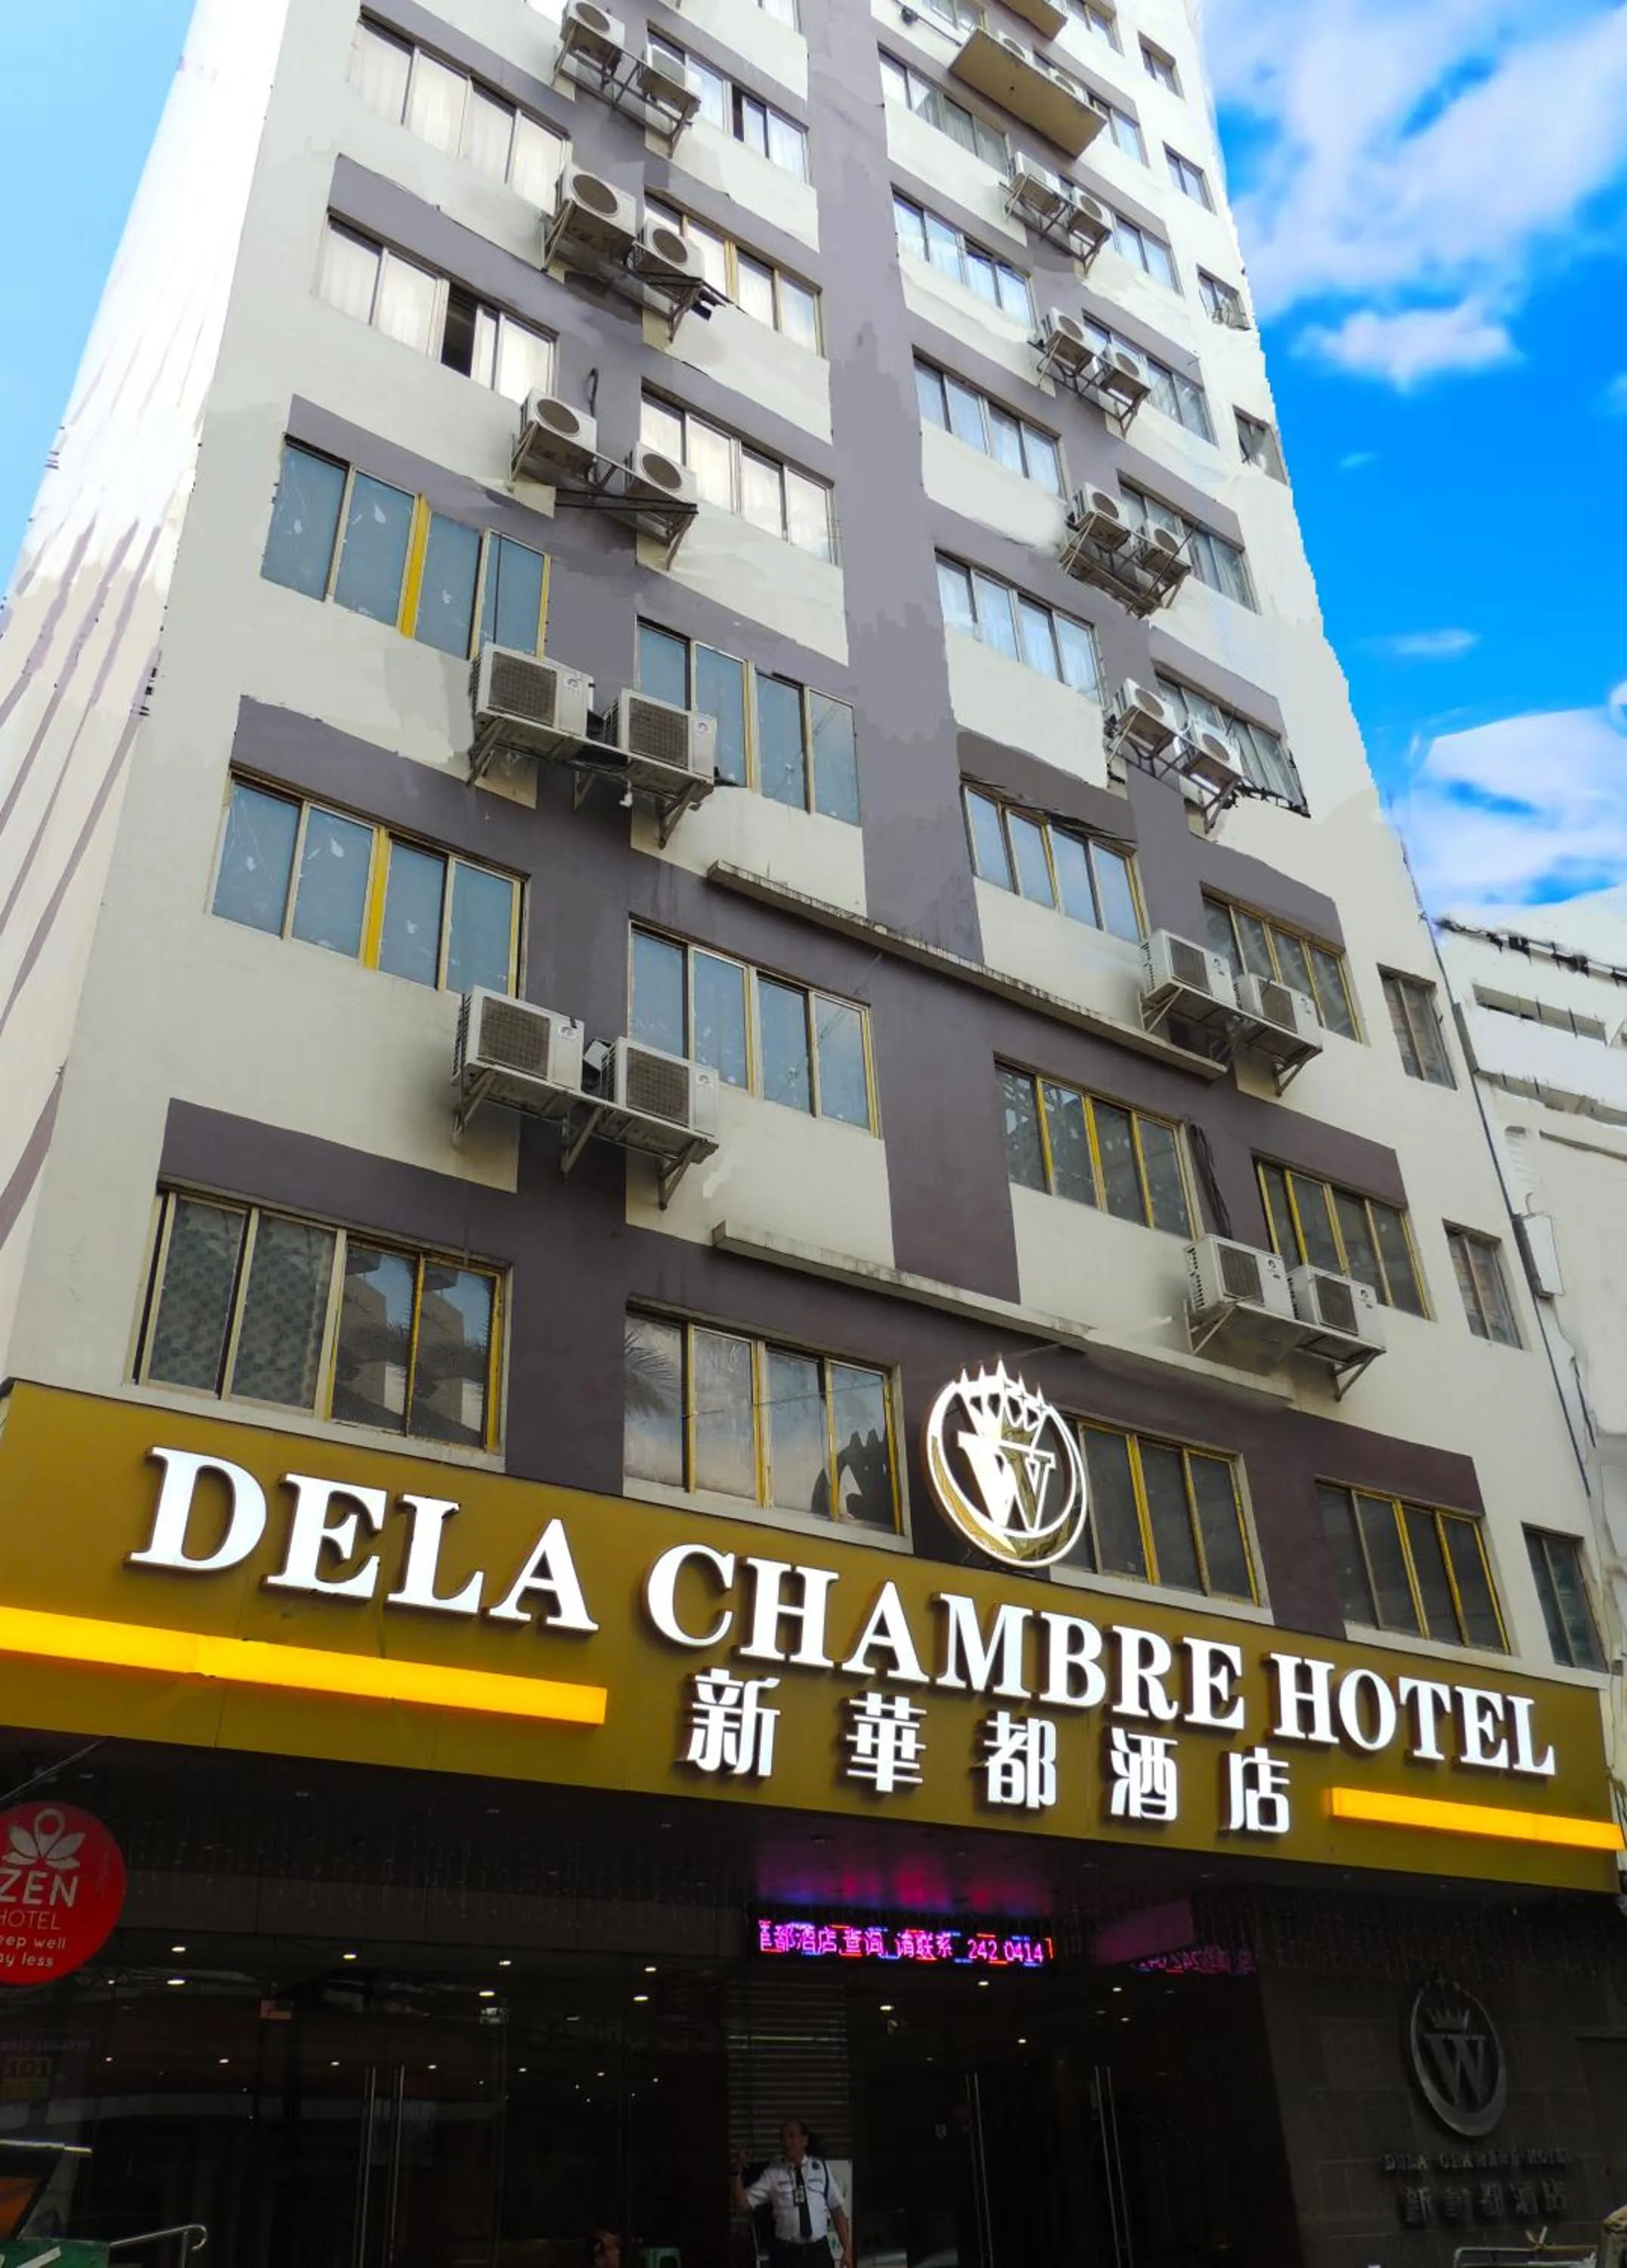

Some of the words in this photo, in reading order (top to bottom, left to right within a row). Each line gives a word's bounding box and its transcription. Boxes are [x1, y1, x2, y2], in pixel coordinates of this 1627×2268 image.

[130, 1446, 600, 1631] DELA
[647, 1544, 1244, 1730] CHAMBRE
[1270, 1653, 1555, 1775] HOTEL
[686, 1668, 1290, 1833] 新華都酒店
[0, 1868, 79, 1908] ZEN
[33, 1935, 67, 1950] well
[967, 1938, 998, 1960] 242
[1003, 1940, 1044, 1963] 0414
[21, 1952, 54, 1967] less
